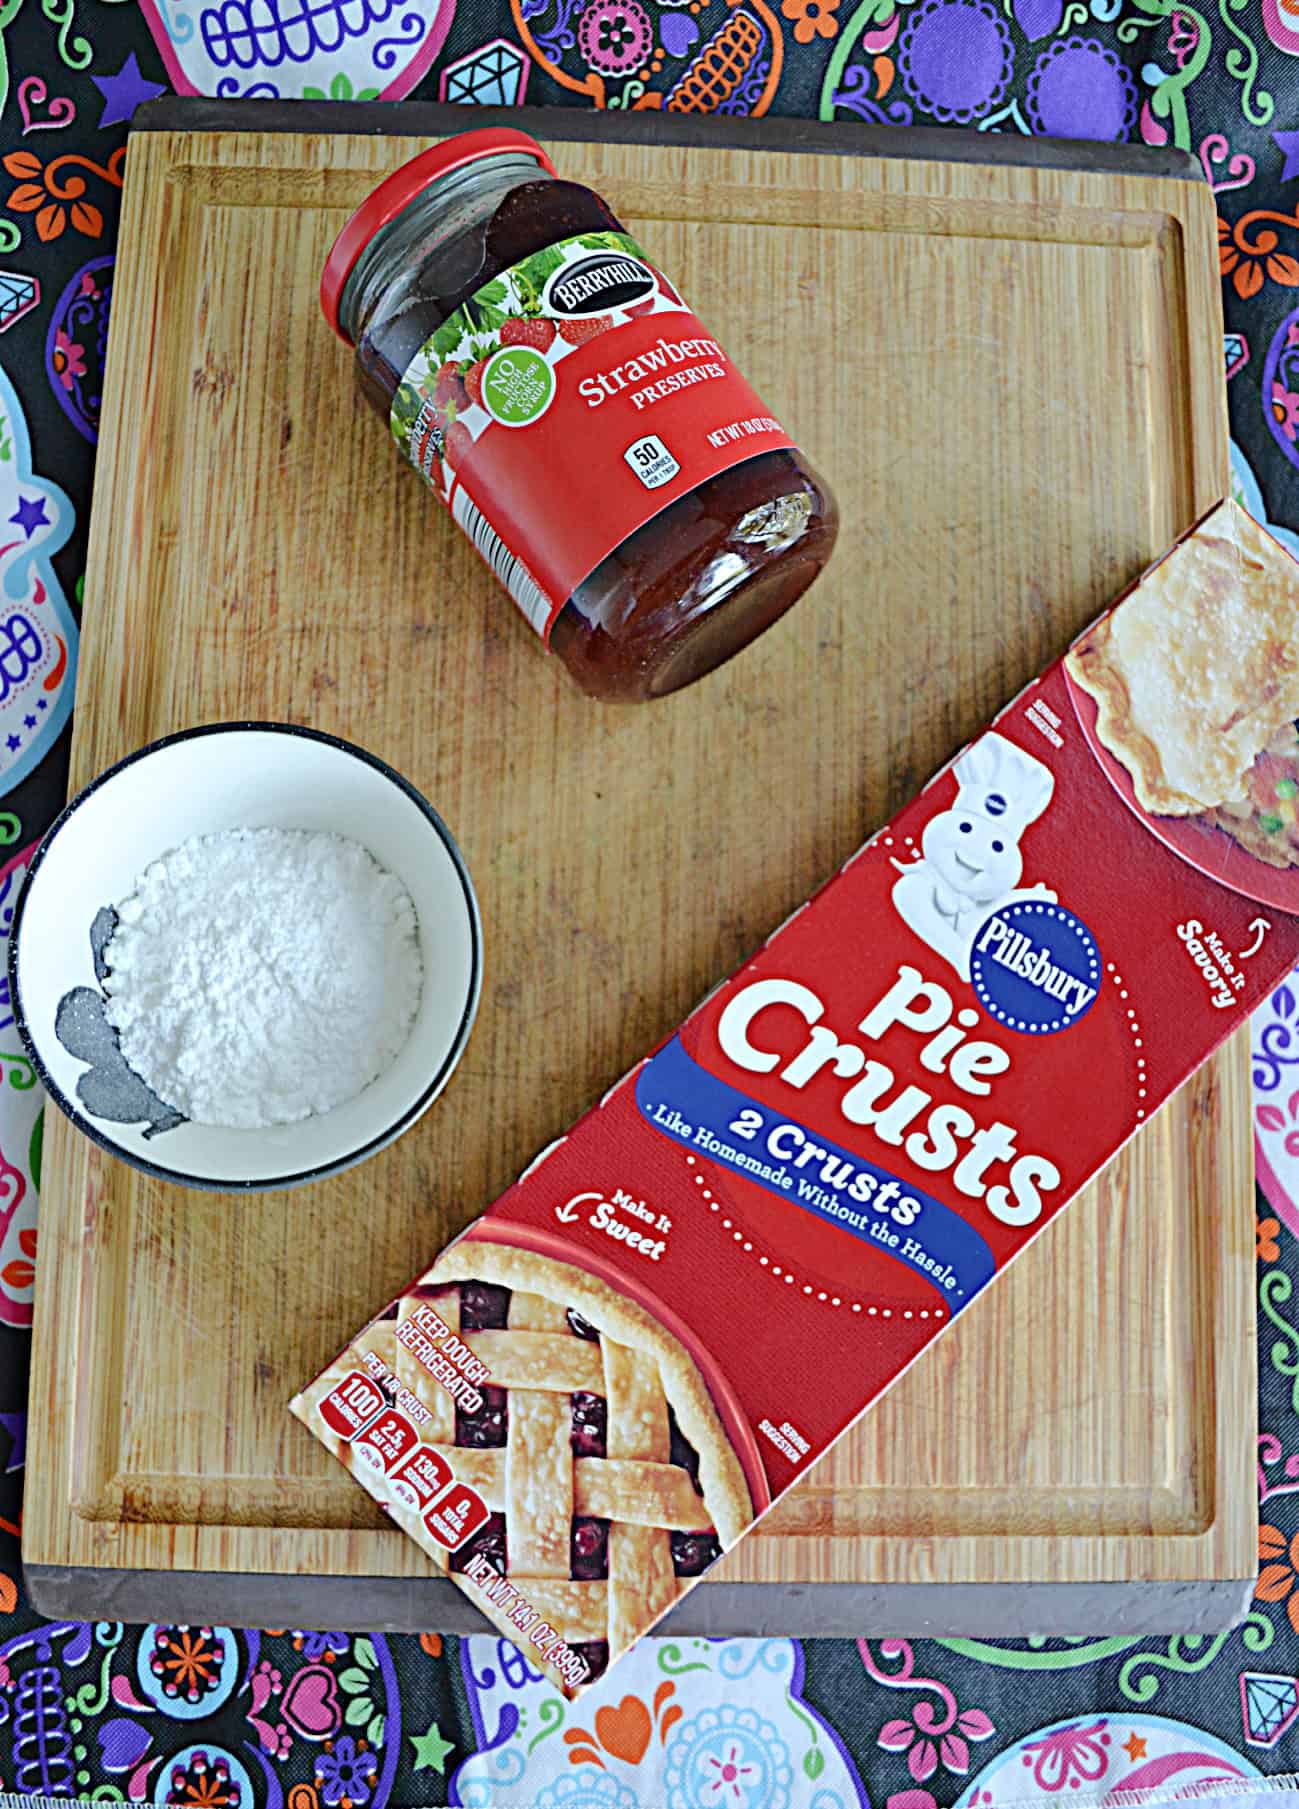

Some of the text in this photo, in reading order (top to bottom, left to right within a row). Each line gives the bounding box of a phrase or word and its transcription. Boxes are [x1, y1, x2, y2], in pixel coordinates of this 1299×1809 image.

[554, 262, 648, 310] BERRYHILL
[488, 359, 515, 393] NO
[502, 368, 523, 397] HIGH
[516, 378, 538, 407] CORN
[521, 381, 545, 416] SYRUP
[578, 338, 726, 407] Strawberry
[629, 362, 726, 410] PRESERVES
[633, 442, 659, 466] 50
[706, 429, 730, 449] NET
[725, 422, 746, 440] WT
[640, 455, 673, 480] CALORIES
[975, 916, 1097, 1015] Pillsbury
[1176, 919, 1237, 1009] Savory
[1203, 931, 1246, 990] Make It
[857, 965, 1011, 1096] Pie
[716, 977, 1061, 1227] Crusts
[651, 1103, 959, 1291] Like Homemade Without the Hassle
[729, 1108, 923, 1227] 2 Crusts
[589, 1202, 667, 1261] Sweet
[611, 1188, 672, 1234] Make It
[395, 1319, 484, 1414] REFRIGERATED
[411, 1304, 492, 1387] KEEP DOUGH
[341, 1378, 379, 1417] 100
[362, 1351, 386, 1379] PER
[397, 1386, 433, 1426] CRUST
[462, 1552, 591, 1688] NET WT 14.1 OZ (399g)
